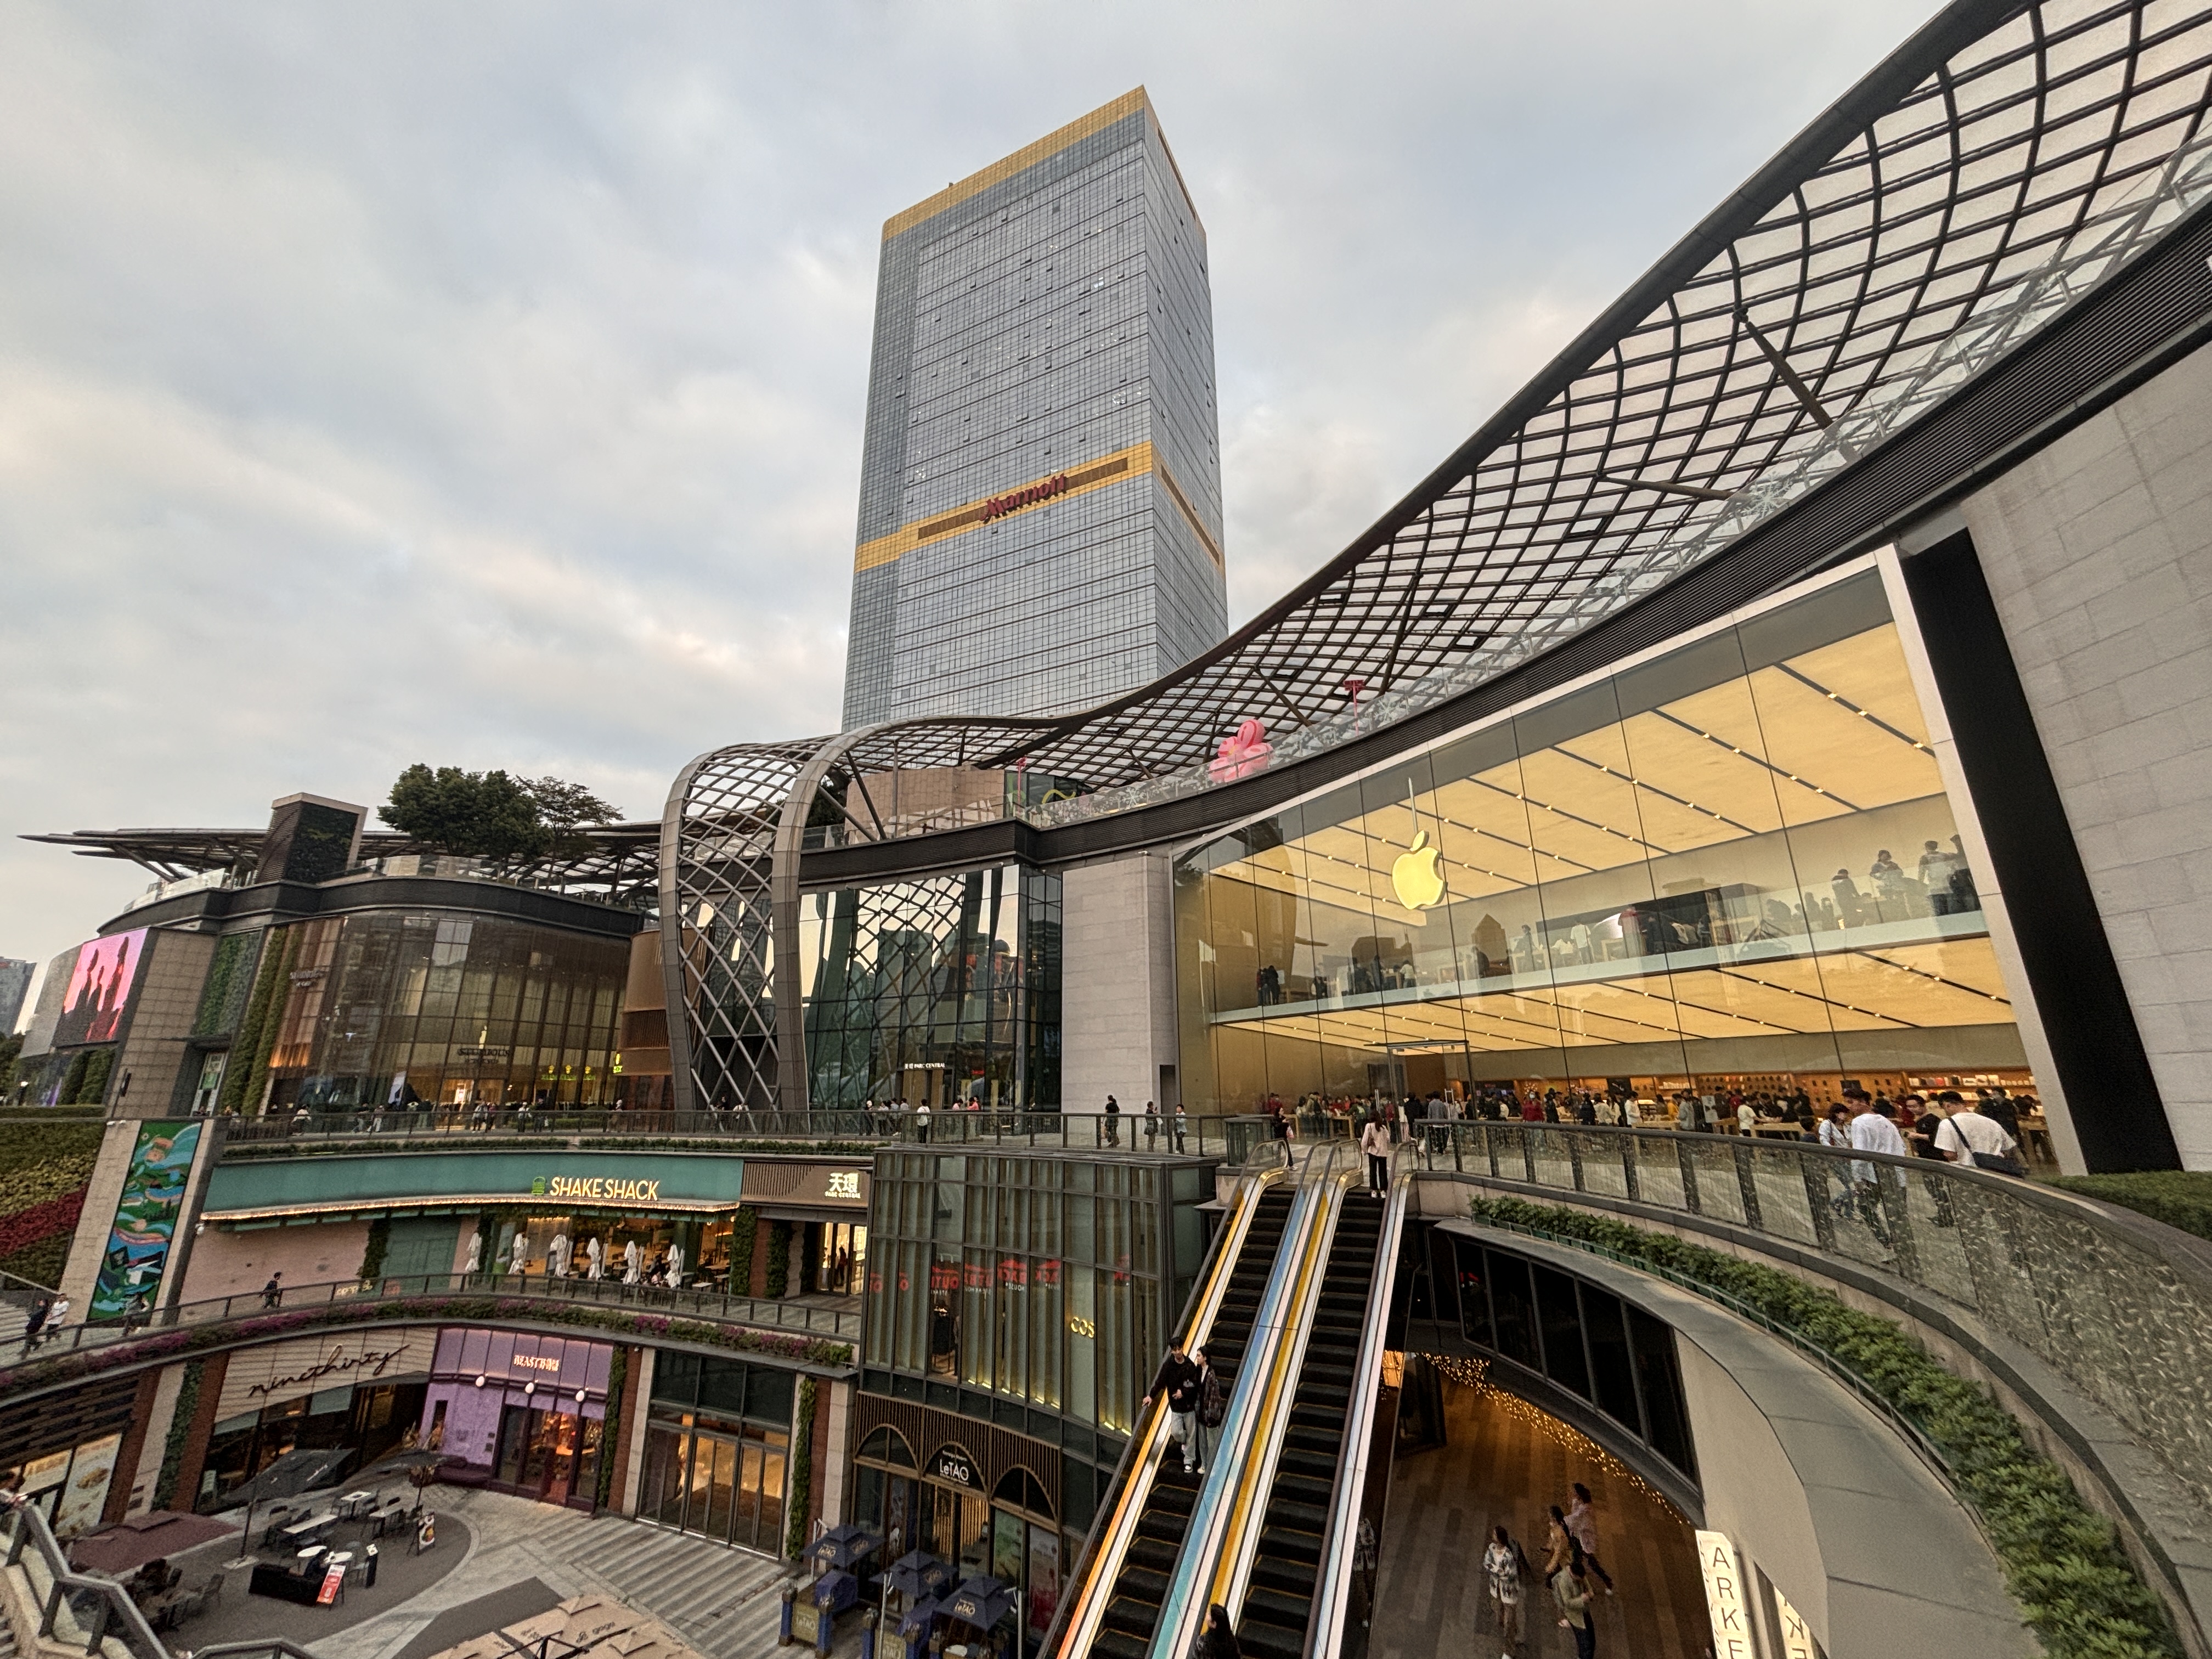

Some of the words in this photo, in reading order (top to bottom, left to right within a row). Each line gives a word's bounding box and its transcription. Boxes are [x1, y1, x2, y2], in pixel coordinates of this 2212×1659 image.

[979, 473, 1066, 522] Marriott
[549, 1176, 603, 1198] SHAKE
[603, 1179, 659, 1201] SHACK
[1071, 1316, 1094, 1339] COS
[940, 1458, 969, 1481] LeTAO
